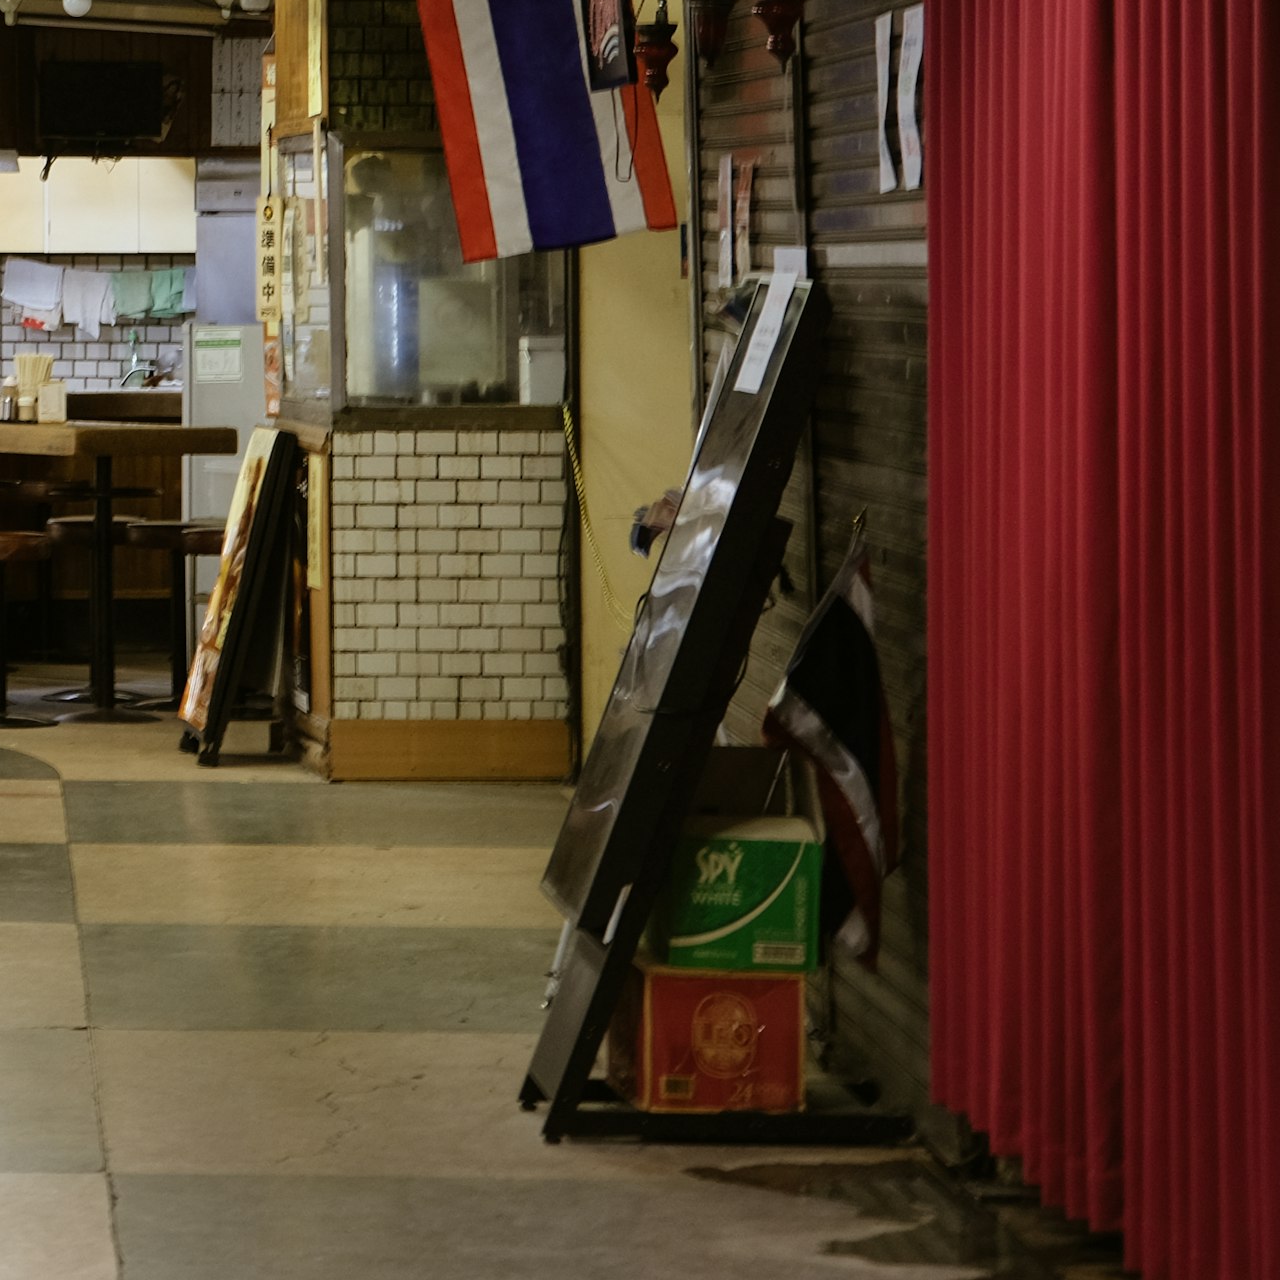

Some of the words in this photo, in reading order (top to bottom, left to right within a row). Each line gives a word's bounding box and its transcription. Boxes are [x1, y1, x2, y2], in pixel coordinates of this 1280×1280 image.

[261, 229, 276, 303] 準備中
[696, 842, 744, 884] SPY
